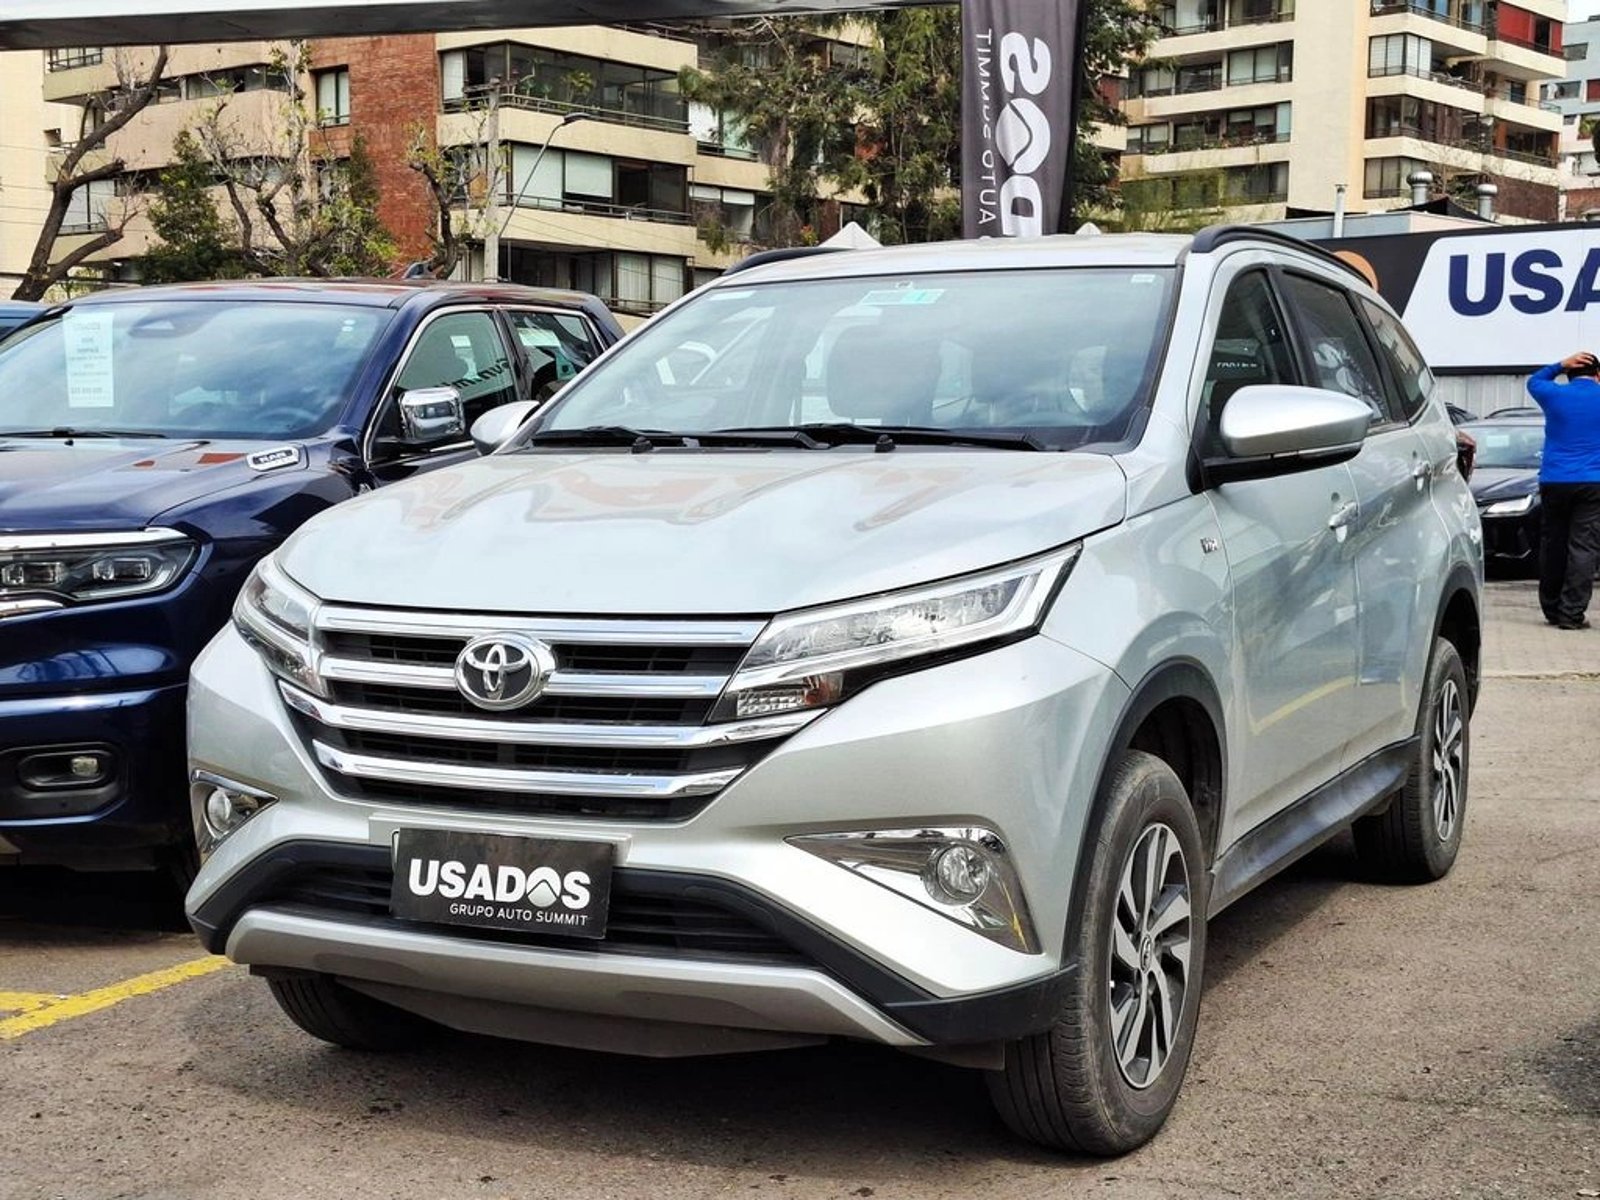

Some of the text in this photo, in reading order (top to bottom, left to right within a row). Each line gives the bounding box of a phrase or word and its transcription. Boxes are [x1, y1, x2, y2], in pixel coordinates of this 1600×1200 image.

[408, 858, 591, 910] USADOS
[449, 902, 588, 926] GRUPO AUTO SUMMIT
